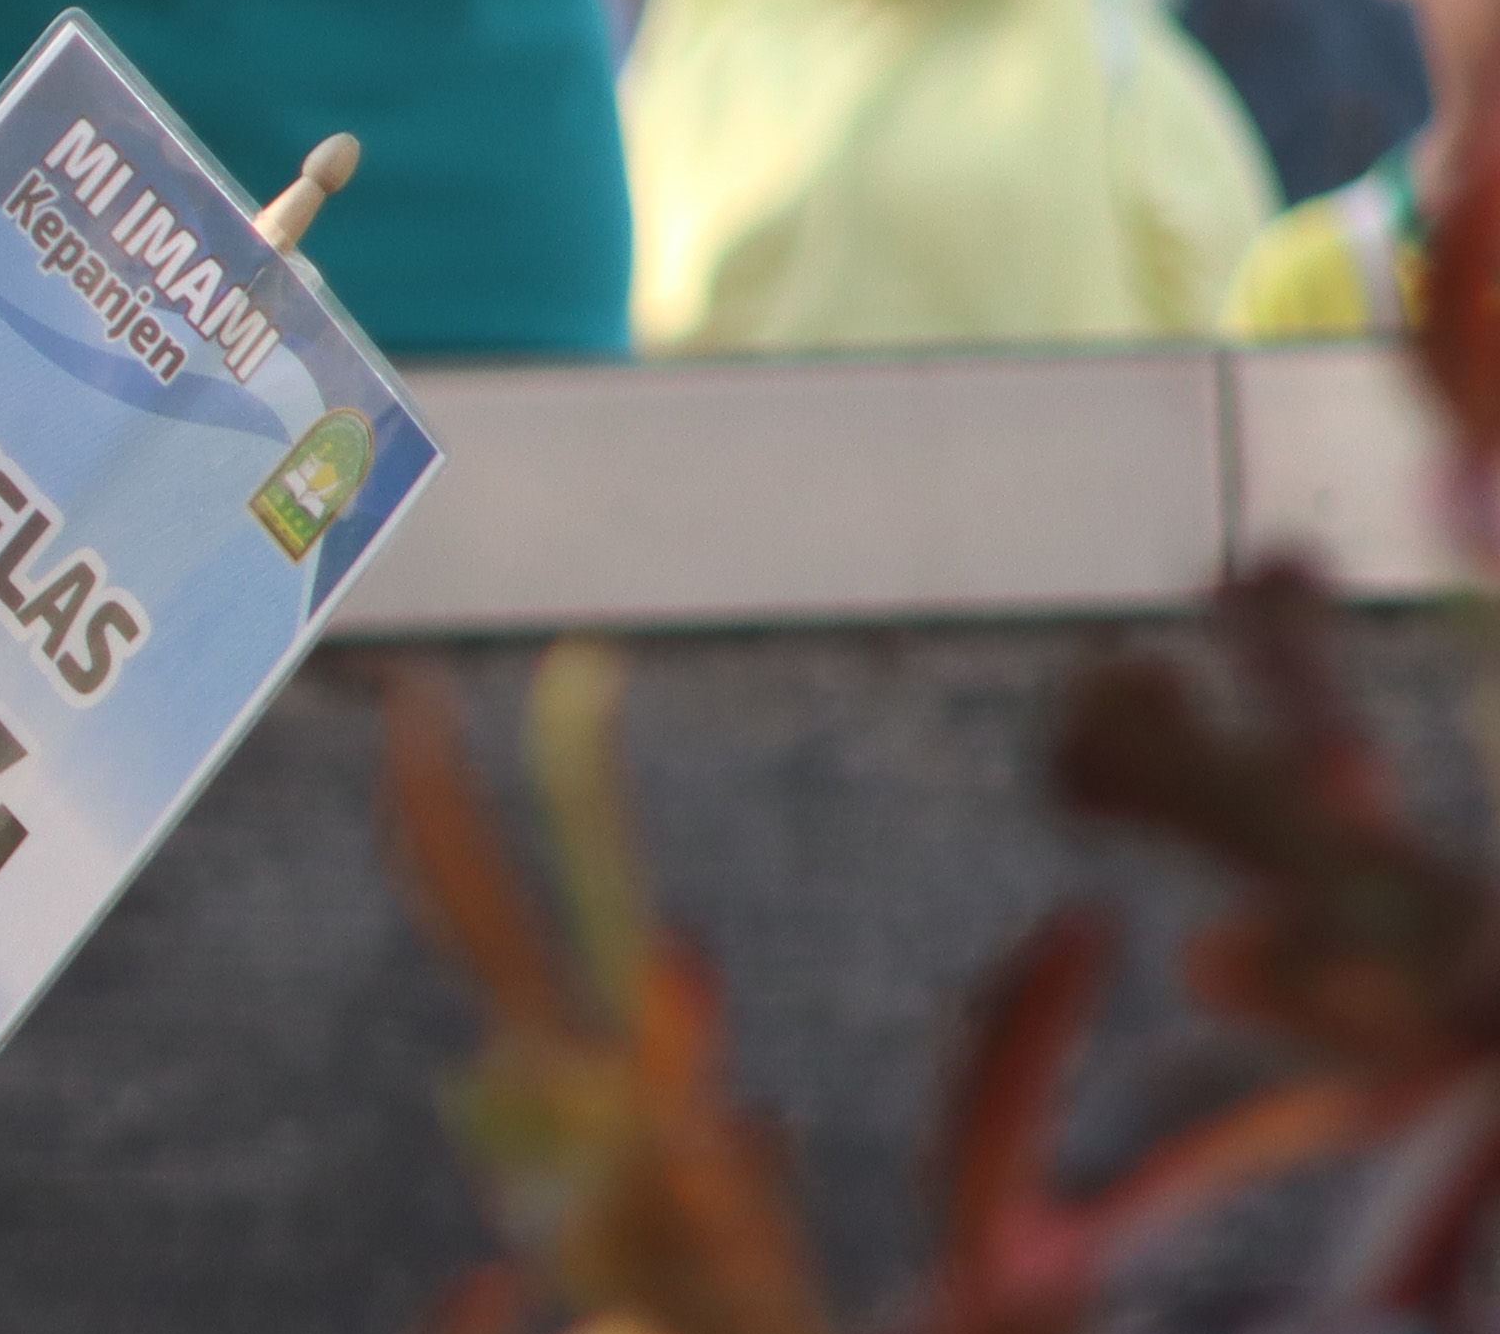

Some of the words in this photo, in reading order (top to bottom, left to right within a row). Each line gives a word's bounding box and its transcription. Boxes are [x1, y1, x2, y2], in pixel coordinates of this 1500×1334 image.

[4, 171, 187, 383] Kepanjen
[42, 116, 135, 218] MI
[109, 187, 281, 385] IMAMI
